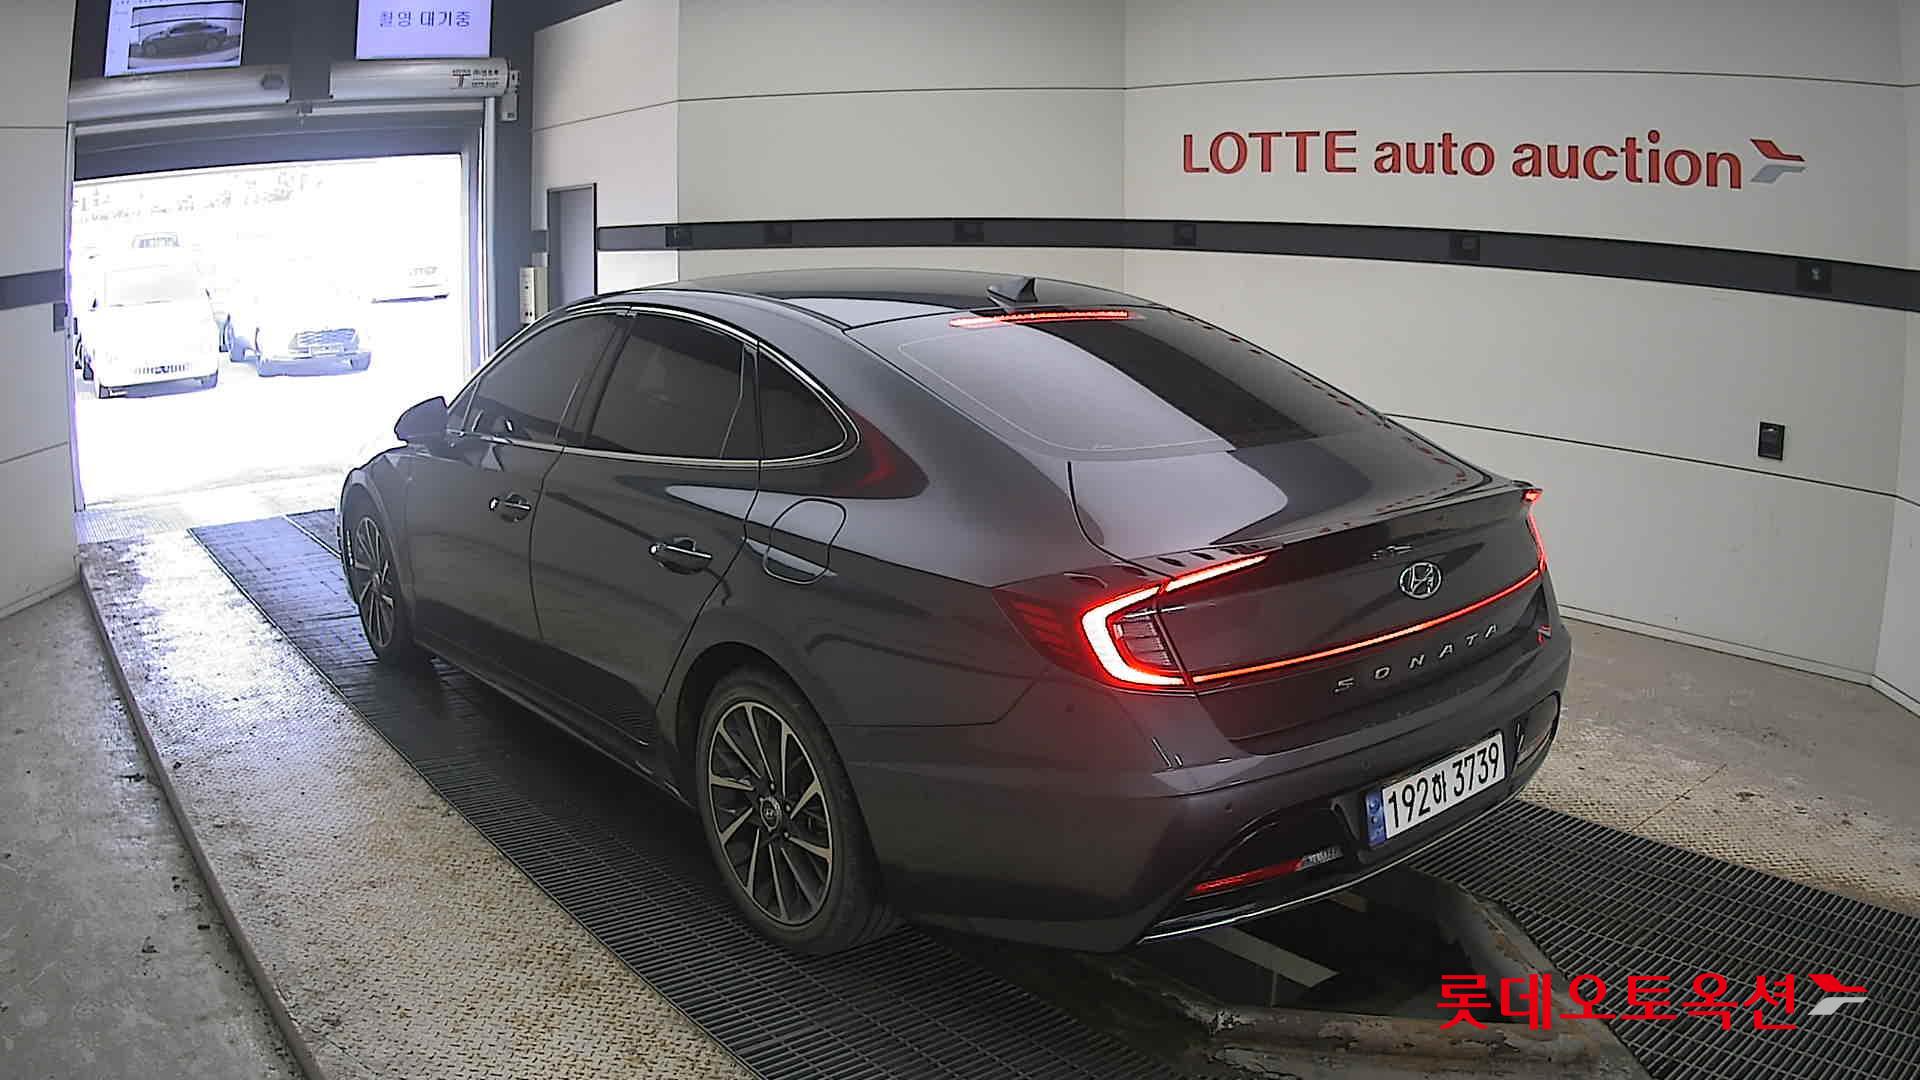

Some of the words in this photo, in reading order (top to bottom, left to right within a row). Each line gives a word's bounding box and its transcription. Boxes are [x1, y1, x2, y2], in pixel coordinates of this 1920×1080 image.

[420, 11, 470, 27] 대기중
[1183, 130, 1357, 174] LOTTE
[1374, 132, 1496, 177] auto
[1512, 130, 1743, 189] auction
[1334, 623, 1498, 693] SONATA
[1388, 770, 1447, 829] 192하
[1452, 742, 1500, 798] 3739
